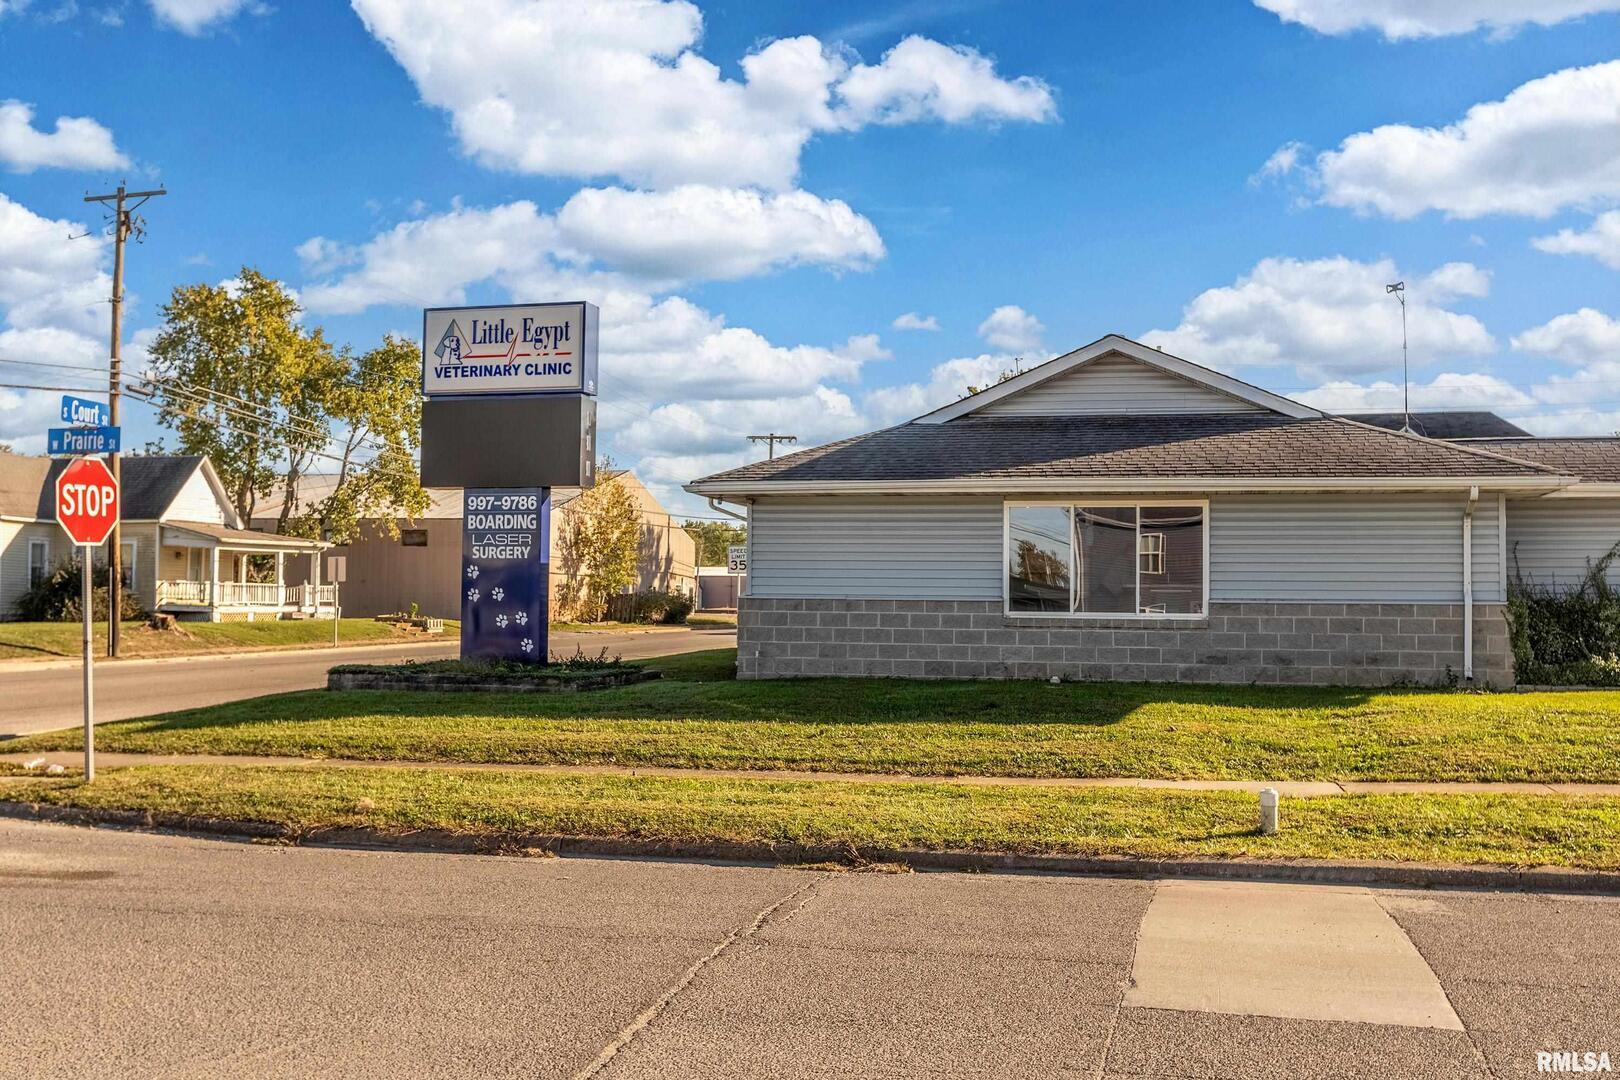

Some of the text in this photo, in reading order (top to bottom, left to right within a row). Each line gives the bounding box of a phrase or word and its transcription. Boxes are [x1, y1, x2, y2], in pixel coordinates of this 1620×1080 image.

[471, 317, 571, 350] Little Egypt
[434, 362, 572, 379] VETERINARY CLINIC
[63, 407, 68, 418] S
[71, 399, 99, 425] Court
[63, 430, 104, 450] Prairie
[61, 483, 115, 517] STOP
[467, 495, 538, 510] 997-9786
[467, 514, 537, 529] BOARDING
[472, 533, 532, 545] LASER
[472, 546, 531, 559] SURGERY
[730, 560, 747, 571] 35
